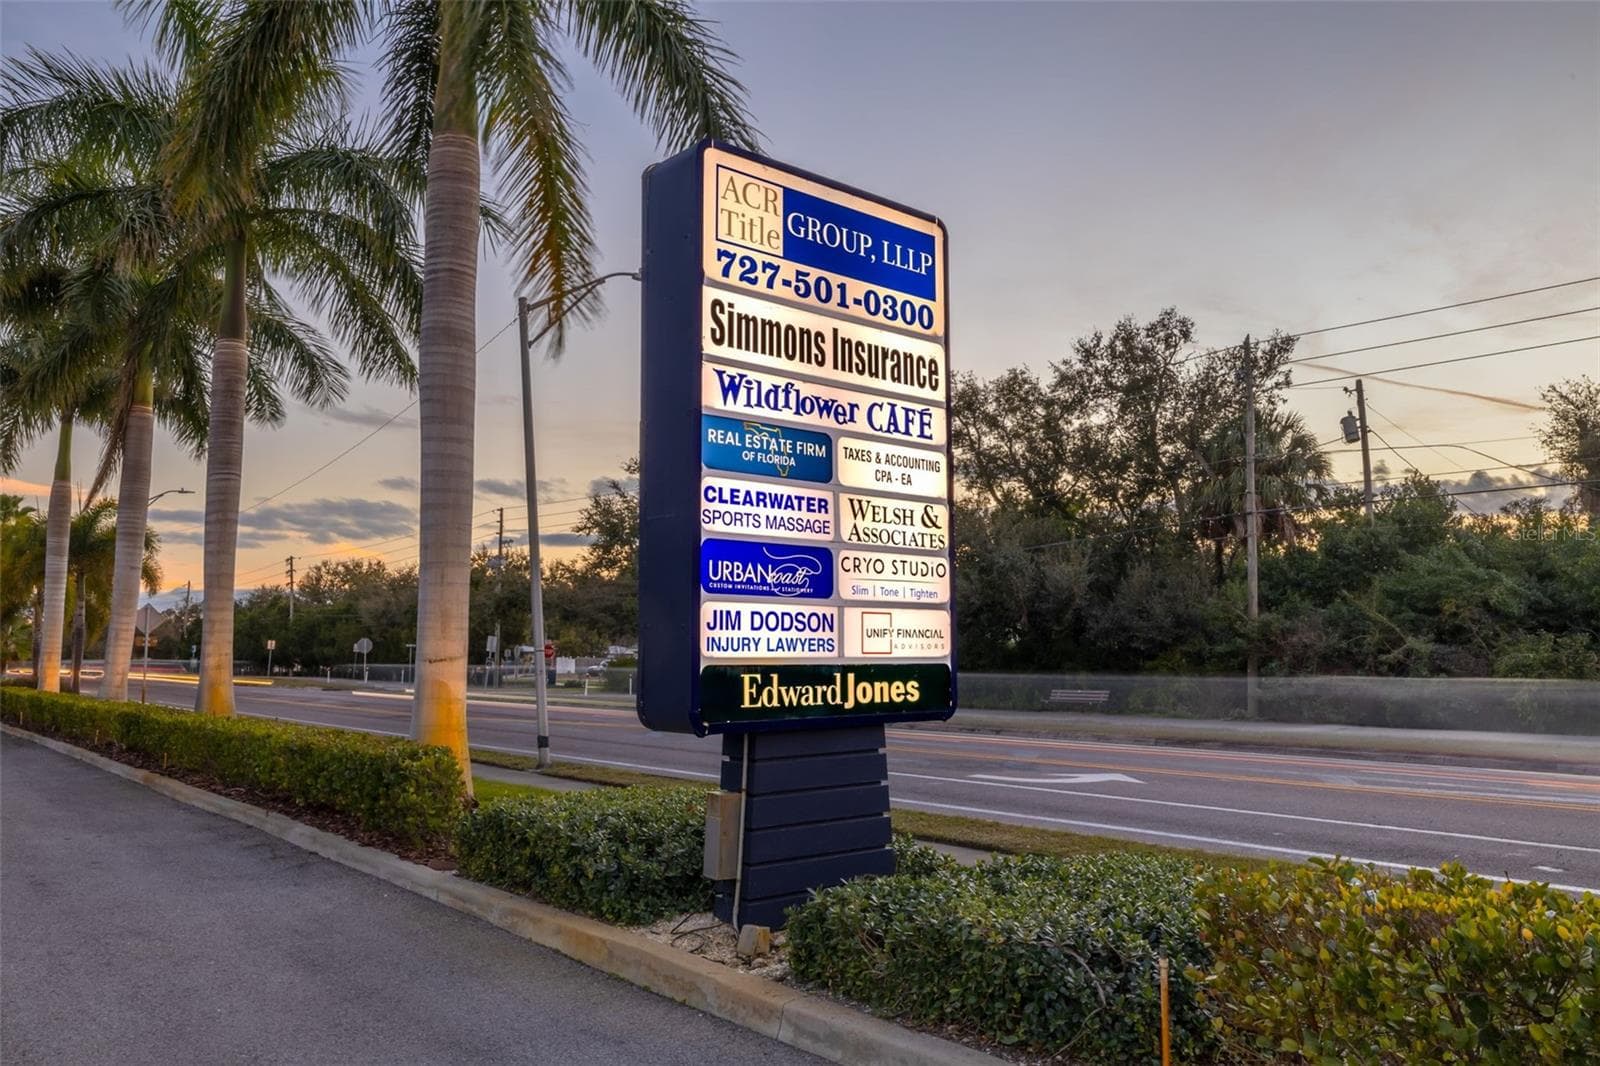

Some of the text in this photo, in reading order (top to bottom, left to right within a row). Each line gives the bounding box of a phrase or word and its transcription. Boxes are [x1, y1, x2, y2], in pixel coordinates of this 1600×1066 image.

[721, 175, 780, 217] ACR
[720, 207, 780, 250] Title
[787, 212, 933, 276] GROUP, LLLP
[716, 248, 934, 330] 727-501-0300
[710, 298, 939, 391] Simmons Insurance
[712, 368, 933, 440] Wildflower CAFÉ
[707, 428, 826, 457] REAL ESTATE FIRM
[742, 450, 796, 466] OF FLORIDA
[843, 446, 941, 473] TAXES & ACCOUNTING
[874, 468, 893, 483] CPA
[901, 473, 912, 486] EA
[703, 485, 829, 514] CLEARWATER
[848, 497, 942, 529] WELSH &
[702, 508, 831, 535] SPORTS MASSAGE
[848, 522, 945, 550] ASSOCIATES
[841, 556, 885, 575] CRYO
[851, 585, 938, 600] Slim Tone Tighten
[706, 609, 834, 633] JIM DODSON
[866, 628, 944, 639] UNIFY FINANCIAL
[706, 636, 835, 652] INJURY LAWYERS
